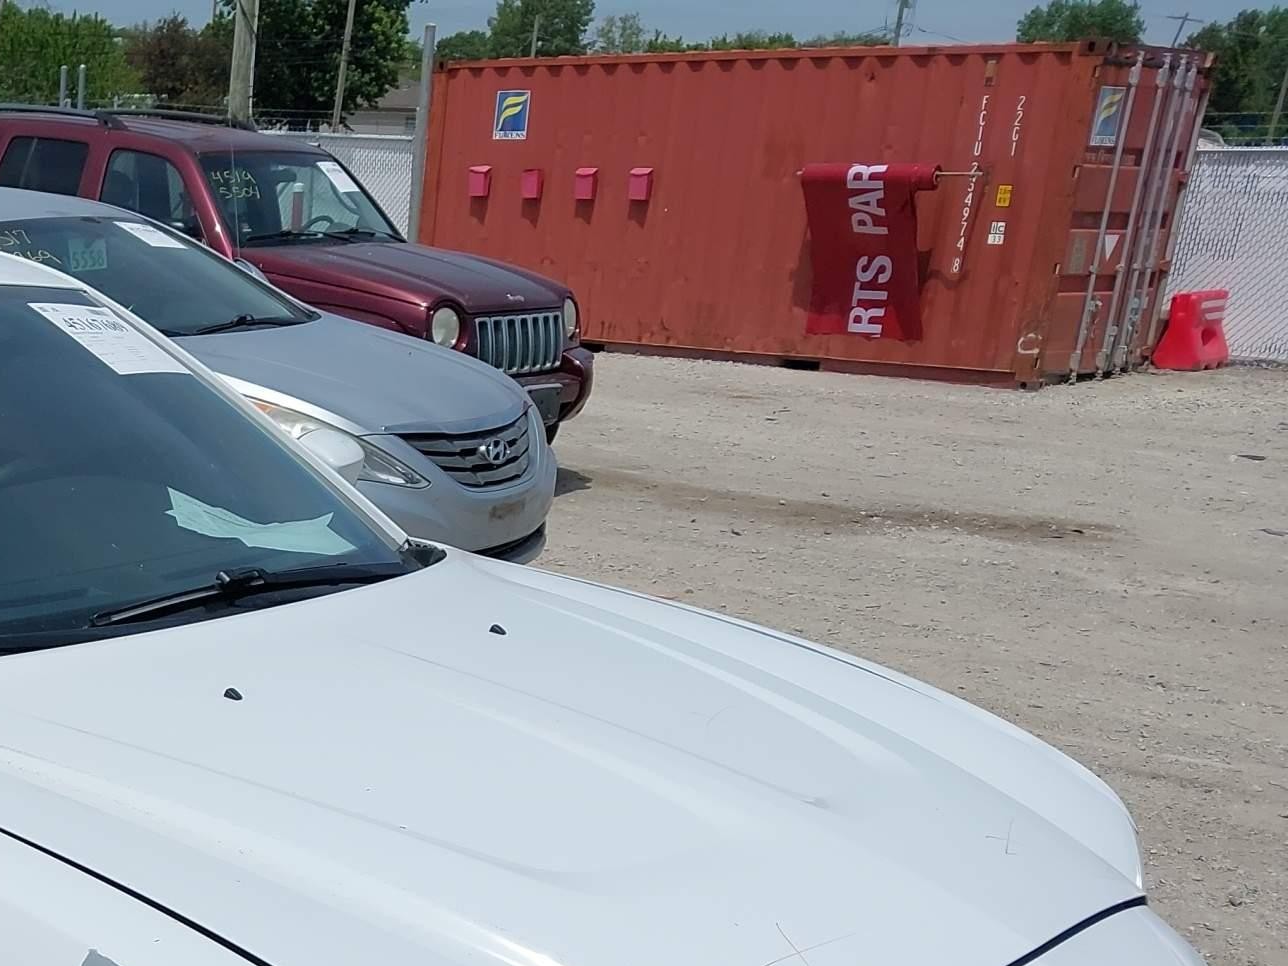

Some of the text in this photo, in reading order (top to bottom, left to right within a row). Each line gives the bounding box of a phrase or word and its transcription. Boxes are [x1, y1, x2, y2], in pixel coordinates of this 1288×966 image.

[974, 95, 989, 157] FCIU
[13, 249, 62, 264] 69
[846, 164, 893, 337] RTS PAR
[952, 258, 961, 273] 8
